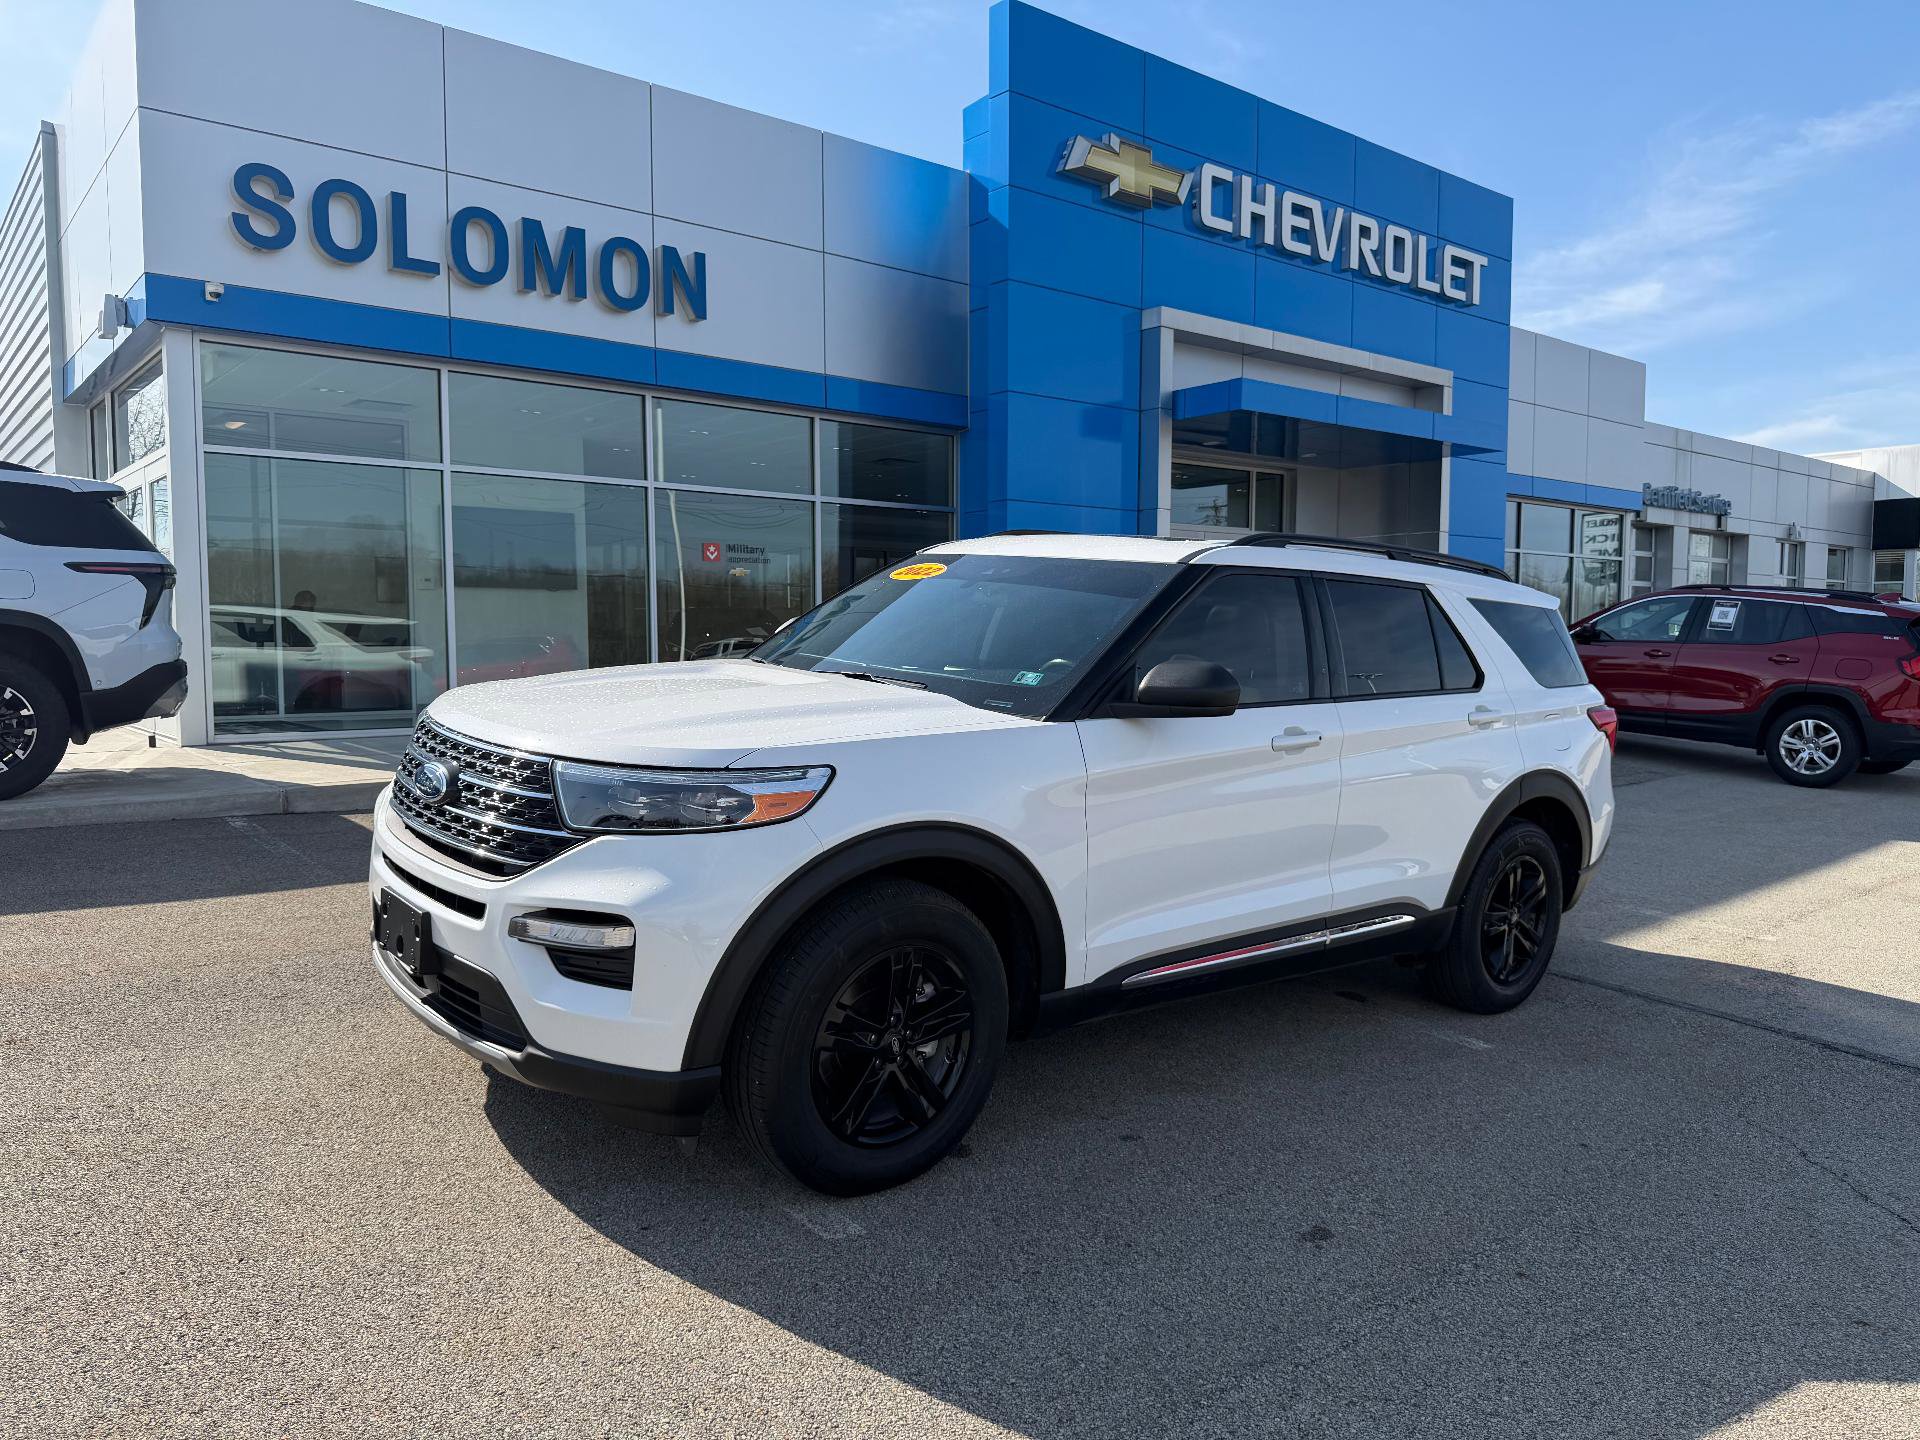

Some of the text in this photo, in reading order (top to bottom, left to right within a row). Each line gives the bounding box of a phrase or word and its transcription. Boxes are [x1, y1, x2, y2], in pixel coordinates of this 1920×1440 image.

[231, 162, 707, 323] SOLOMON
[1192, 162, 1488, 306] CHEVROLET
[727, 544, 765, 556] Military
